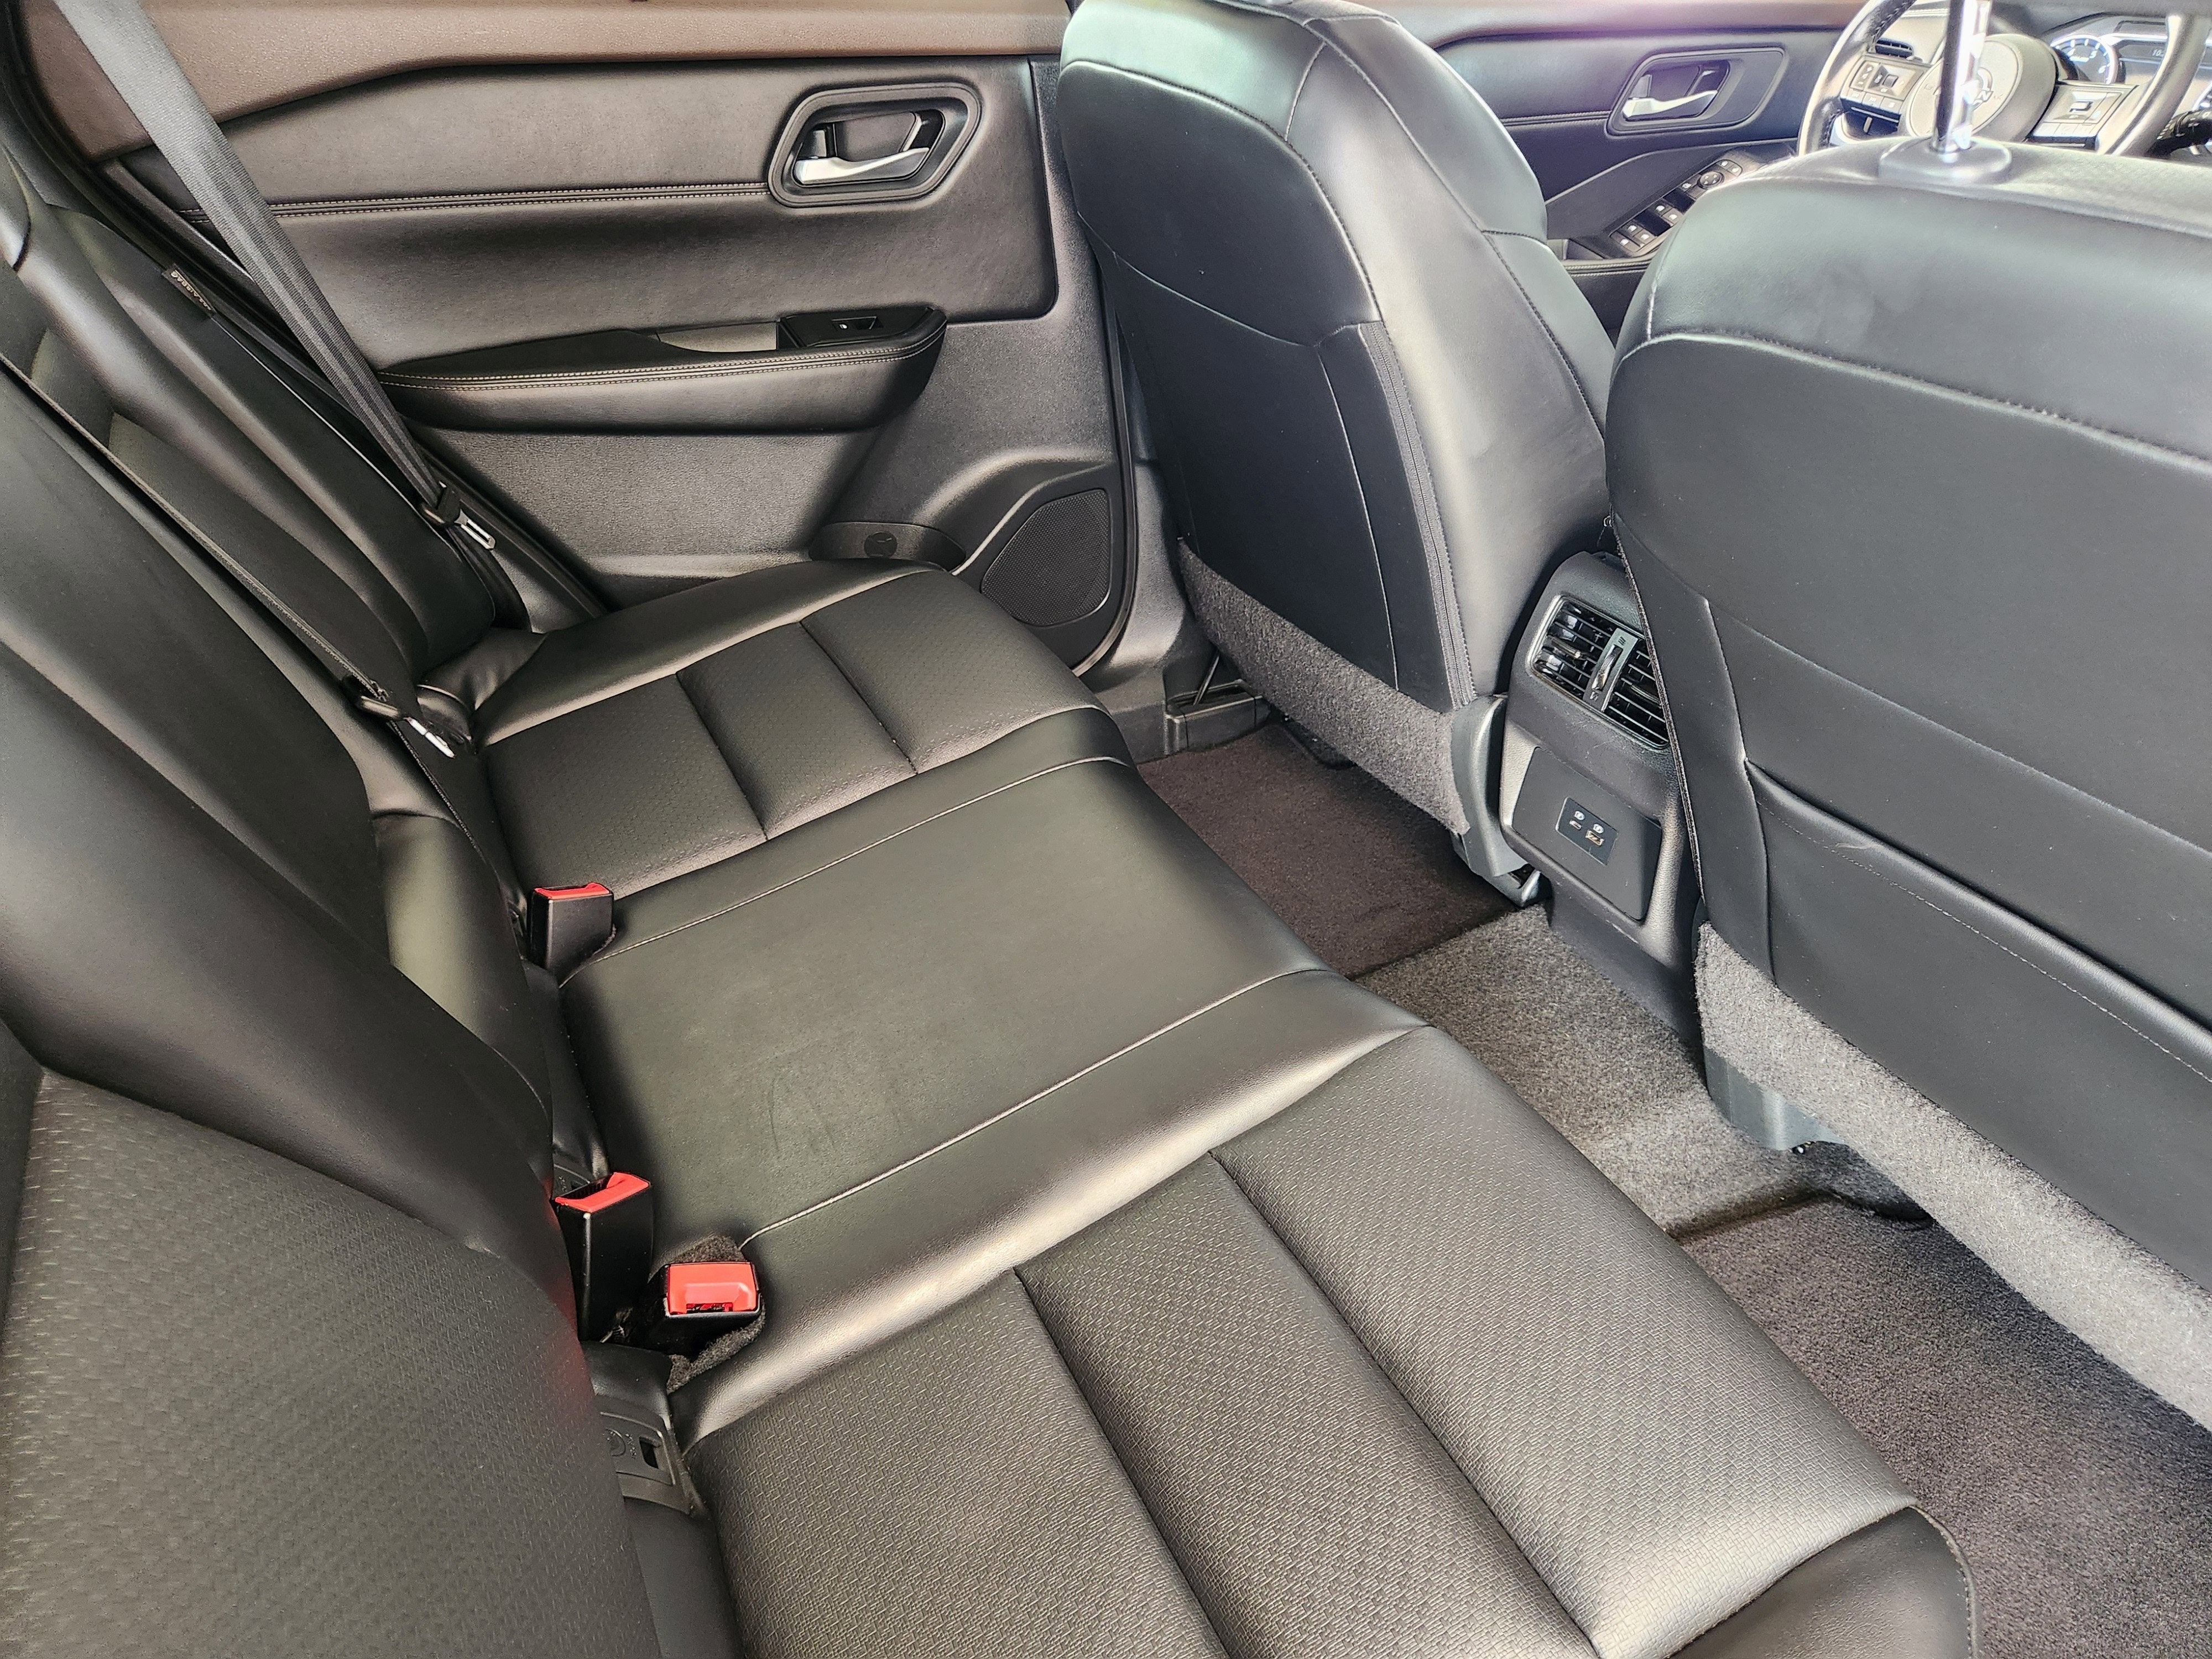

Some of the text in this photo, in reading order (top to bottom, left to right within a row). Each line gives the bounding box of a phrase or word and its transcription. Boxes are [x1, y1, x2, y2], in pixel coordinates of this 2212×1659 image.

[2089, 50, 2097, 59] 5
[2098, 65, 2106, 74] 6
[171, 270, 200, 298] AIRBAG
